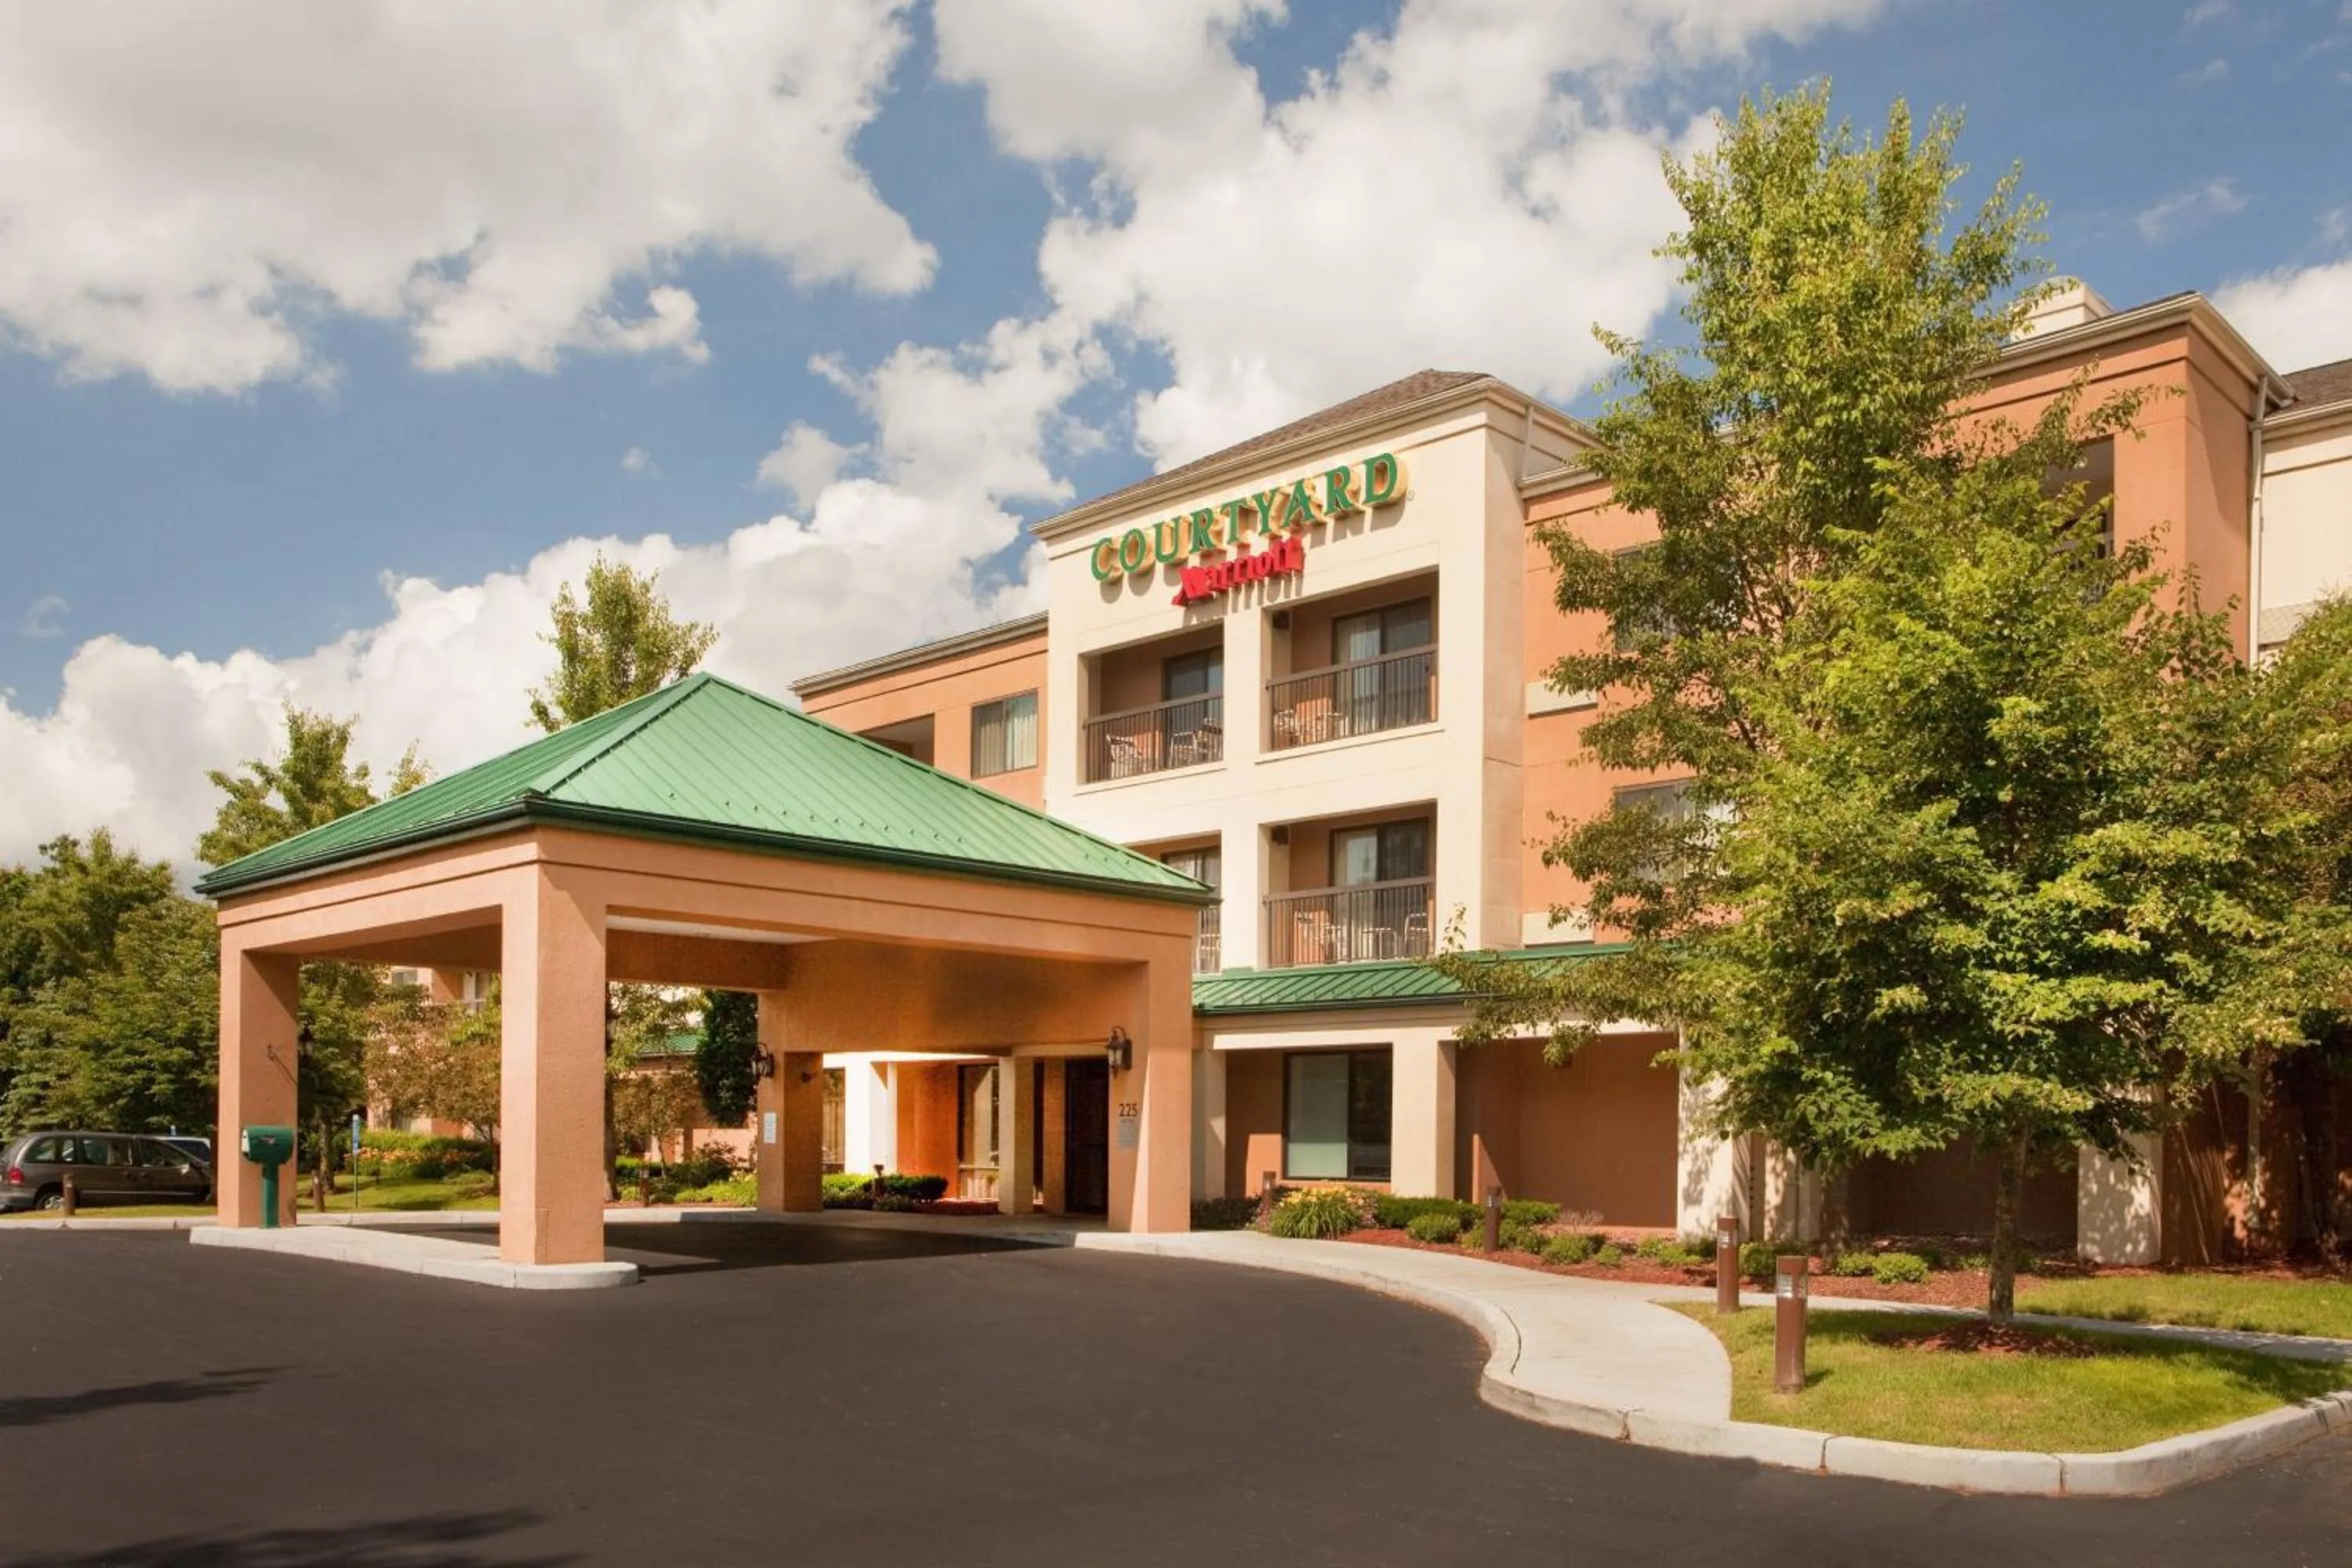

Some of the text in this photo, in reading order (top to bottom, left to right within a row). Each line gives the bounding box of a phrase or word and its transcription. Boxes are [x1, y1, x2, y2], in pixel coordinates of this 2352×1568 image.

[1091, 452, 1406, 583] COURTYARD
[1171, 535, 1305, 606] Marriott
[1119, 1103, 1138, 1117] 225
